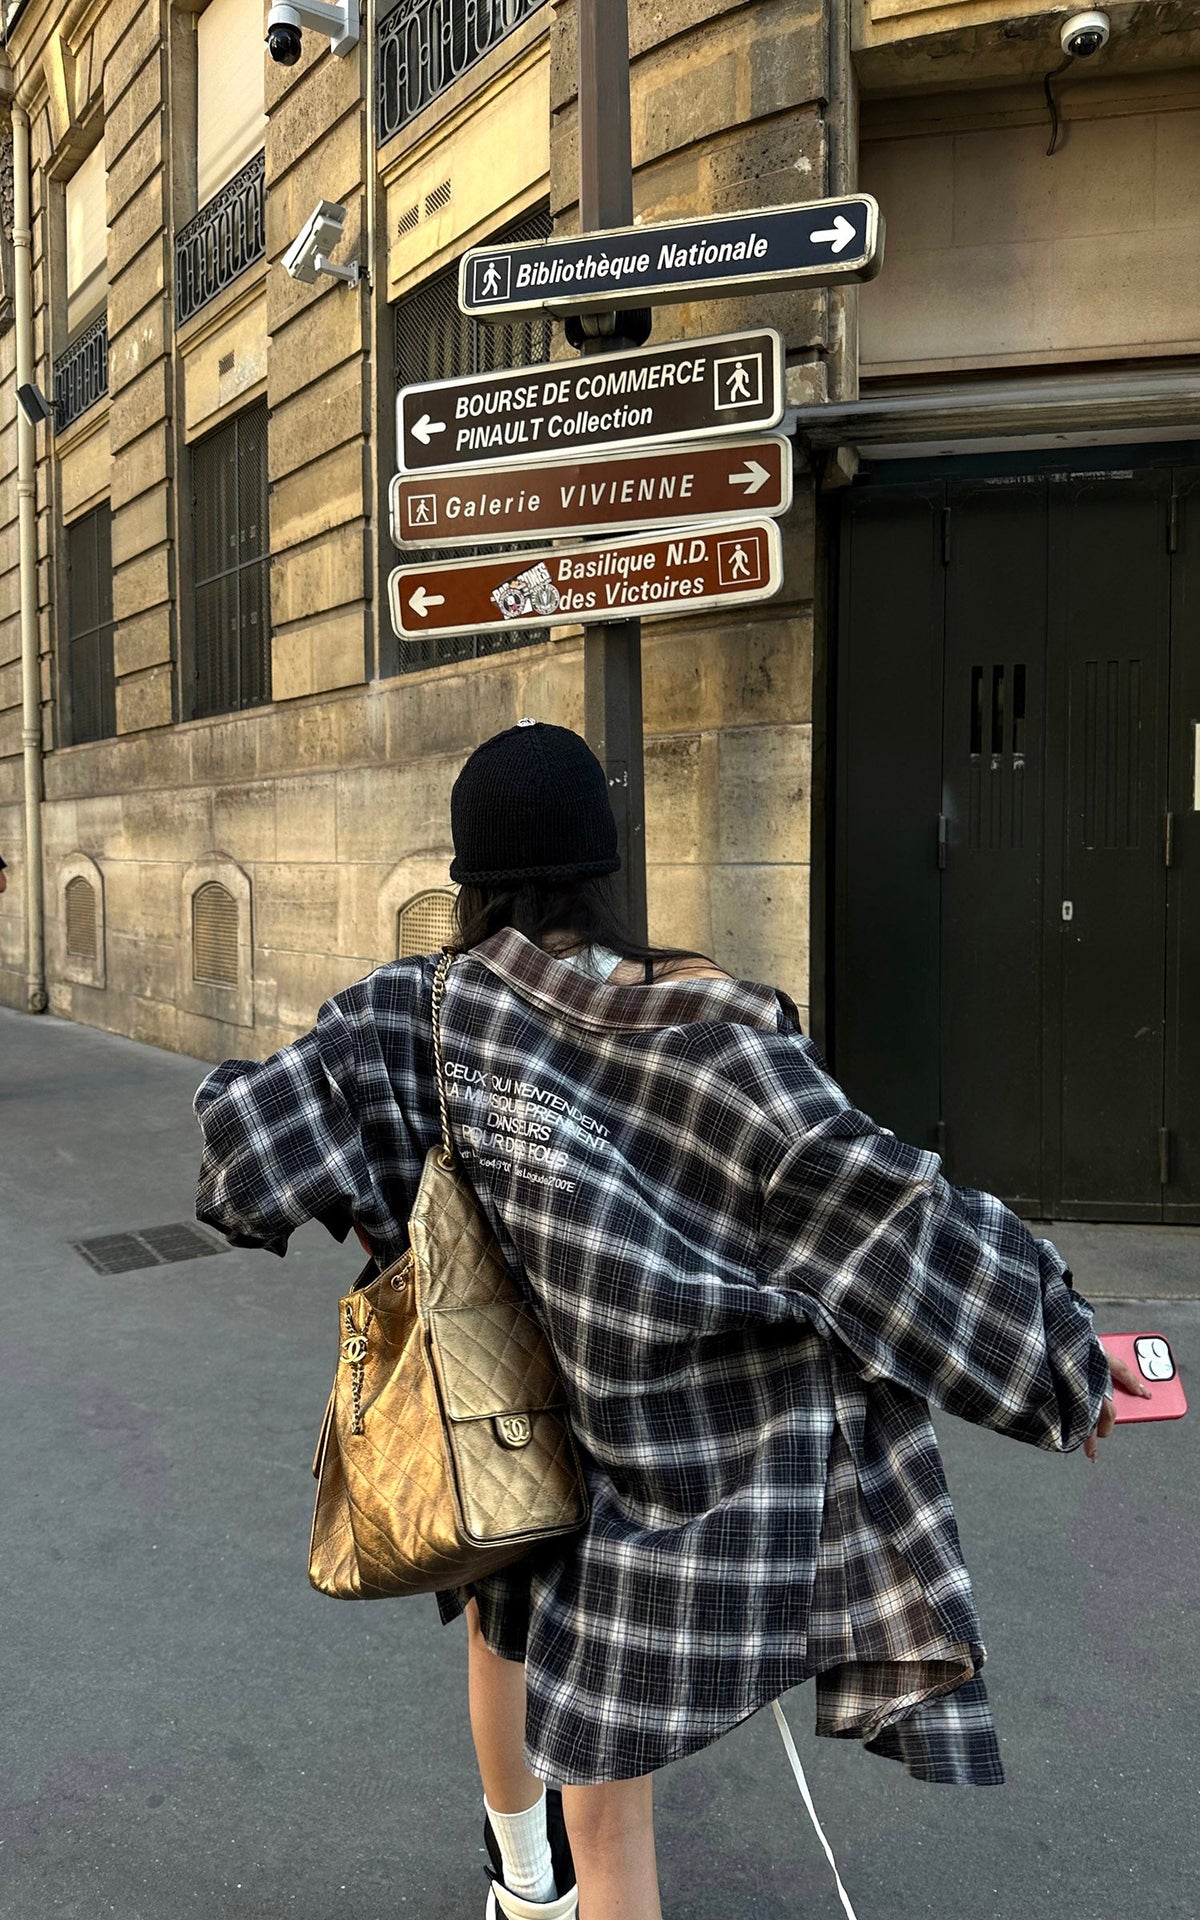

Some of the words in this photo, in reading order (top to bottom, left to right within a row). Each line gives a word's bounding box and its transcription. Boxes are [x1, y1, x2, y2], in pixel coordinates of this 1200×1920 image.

[516, 252, 650, 288] Bibliothèque
[657, 233, 768, 270] Nationale
[455, 385, 538, 419] BOURSE
[542, 380, 571, 406] DE
[575, 358, 706, 400] COMMERCE
[456, 418, 544, 451] PINAULT
[548, 405, 653, 438] Collection
[445, 490, 540, 519] Galerie
[560, 474, 695, 508] VIVIENNE
[557, 552, 656, 581] Basilique
[666, 539, 709, 567] N.D.
[559, 589, 596, 611] des
[605, 576, 705, 605] Victoires
[444, 1061, 488, 1087] CEUX
[492, 1075, 512, 1093] QUI
[445, 1080, 459, 1098] LA
[462, 1124, 504, 1150] POUR
[528, 1142, 569, 1168] FOUS
